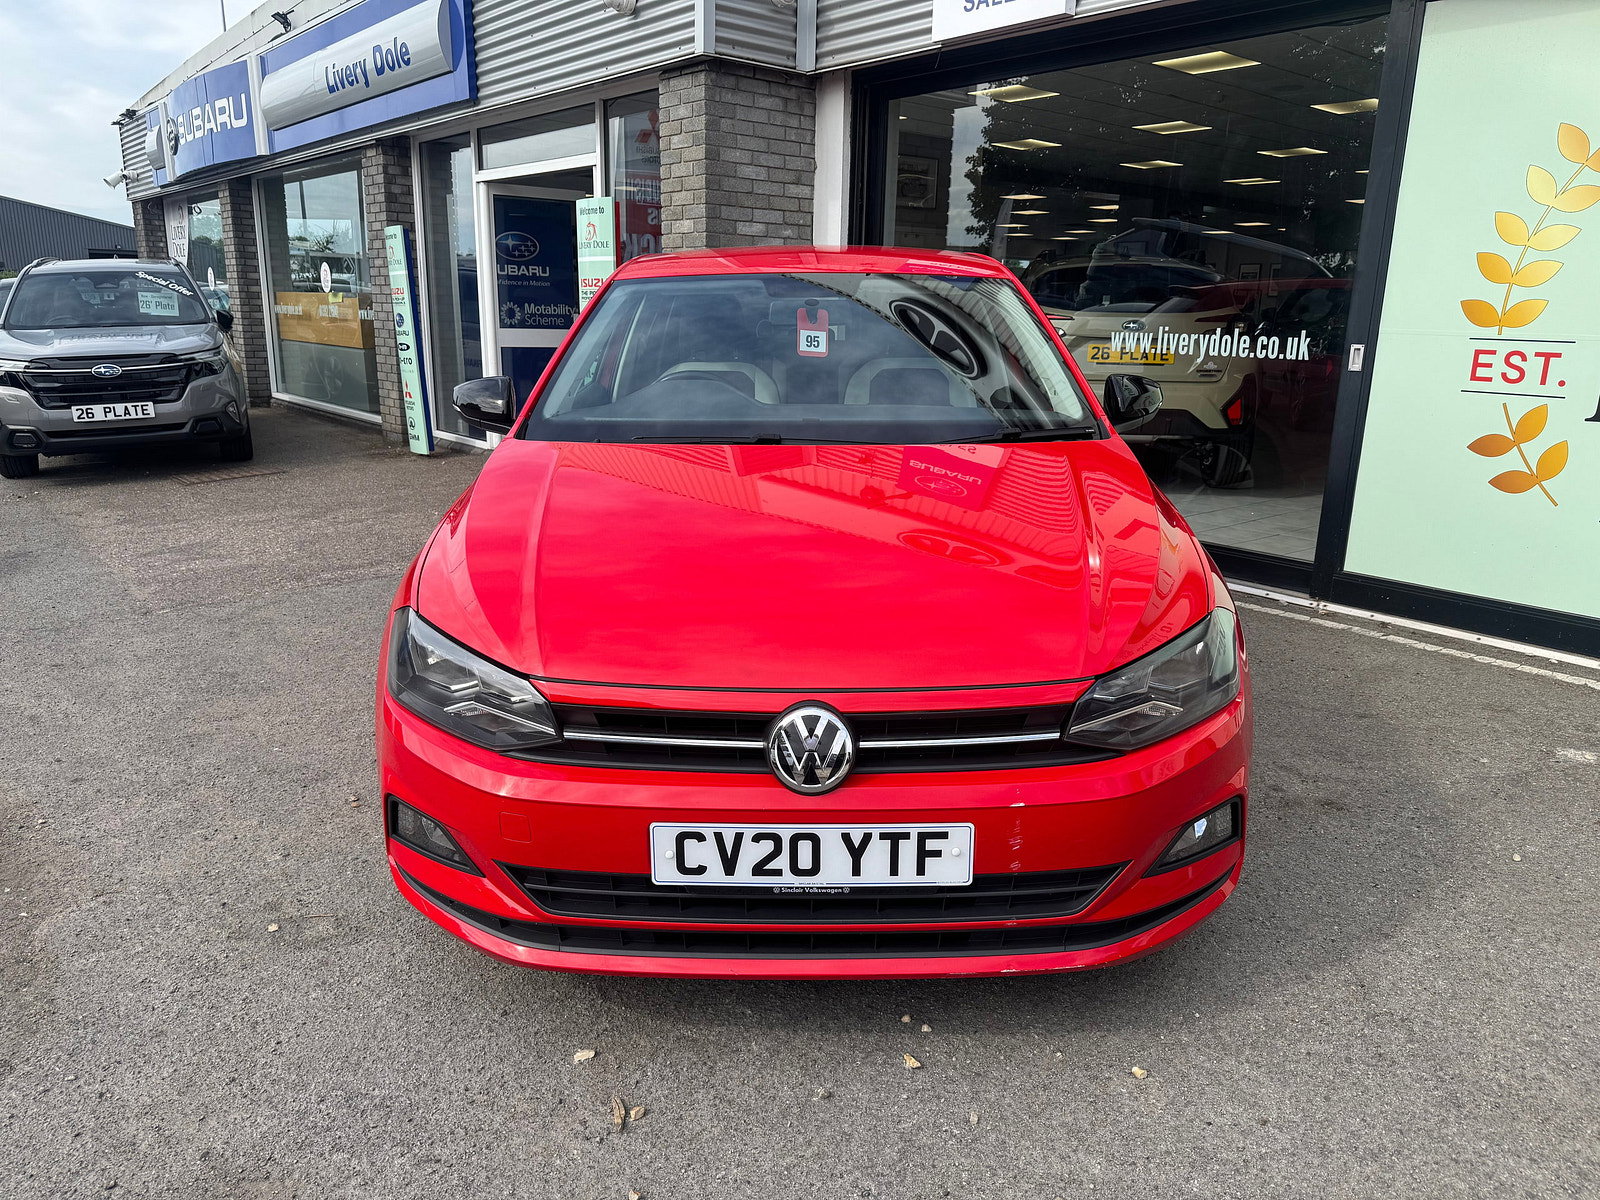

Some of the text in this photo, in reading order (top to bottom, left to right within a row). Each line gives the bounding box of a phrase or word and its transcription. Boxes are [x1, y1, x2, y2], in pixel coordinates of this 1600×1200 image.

[325, 36, 411, 94] Livery Dole
[177, 93, 248, 146] SUBARU
[580, 206, 605, 215] Welcome to
[593, 240, 610, 249] DOLE
[497, 264, 549, 277] UBARU
[135, 271, 194, 296] Special Offer
[155, 301, 175, 310] Plate
[524, 302, 575, 316] Motability
[525, 315, 565, 326] Scheme
[805, 334, 820, 348] 95
[1110, 326, 1312, 364] www.liverydole.co.uk
[1091, 346, 1111, 360] 26
[1469, 349, 1567, 388] EST.
[75, 404, 151, 420] 26 PLATE
[674, 831, 949, 877] CV20 YTF
